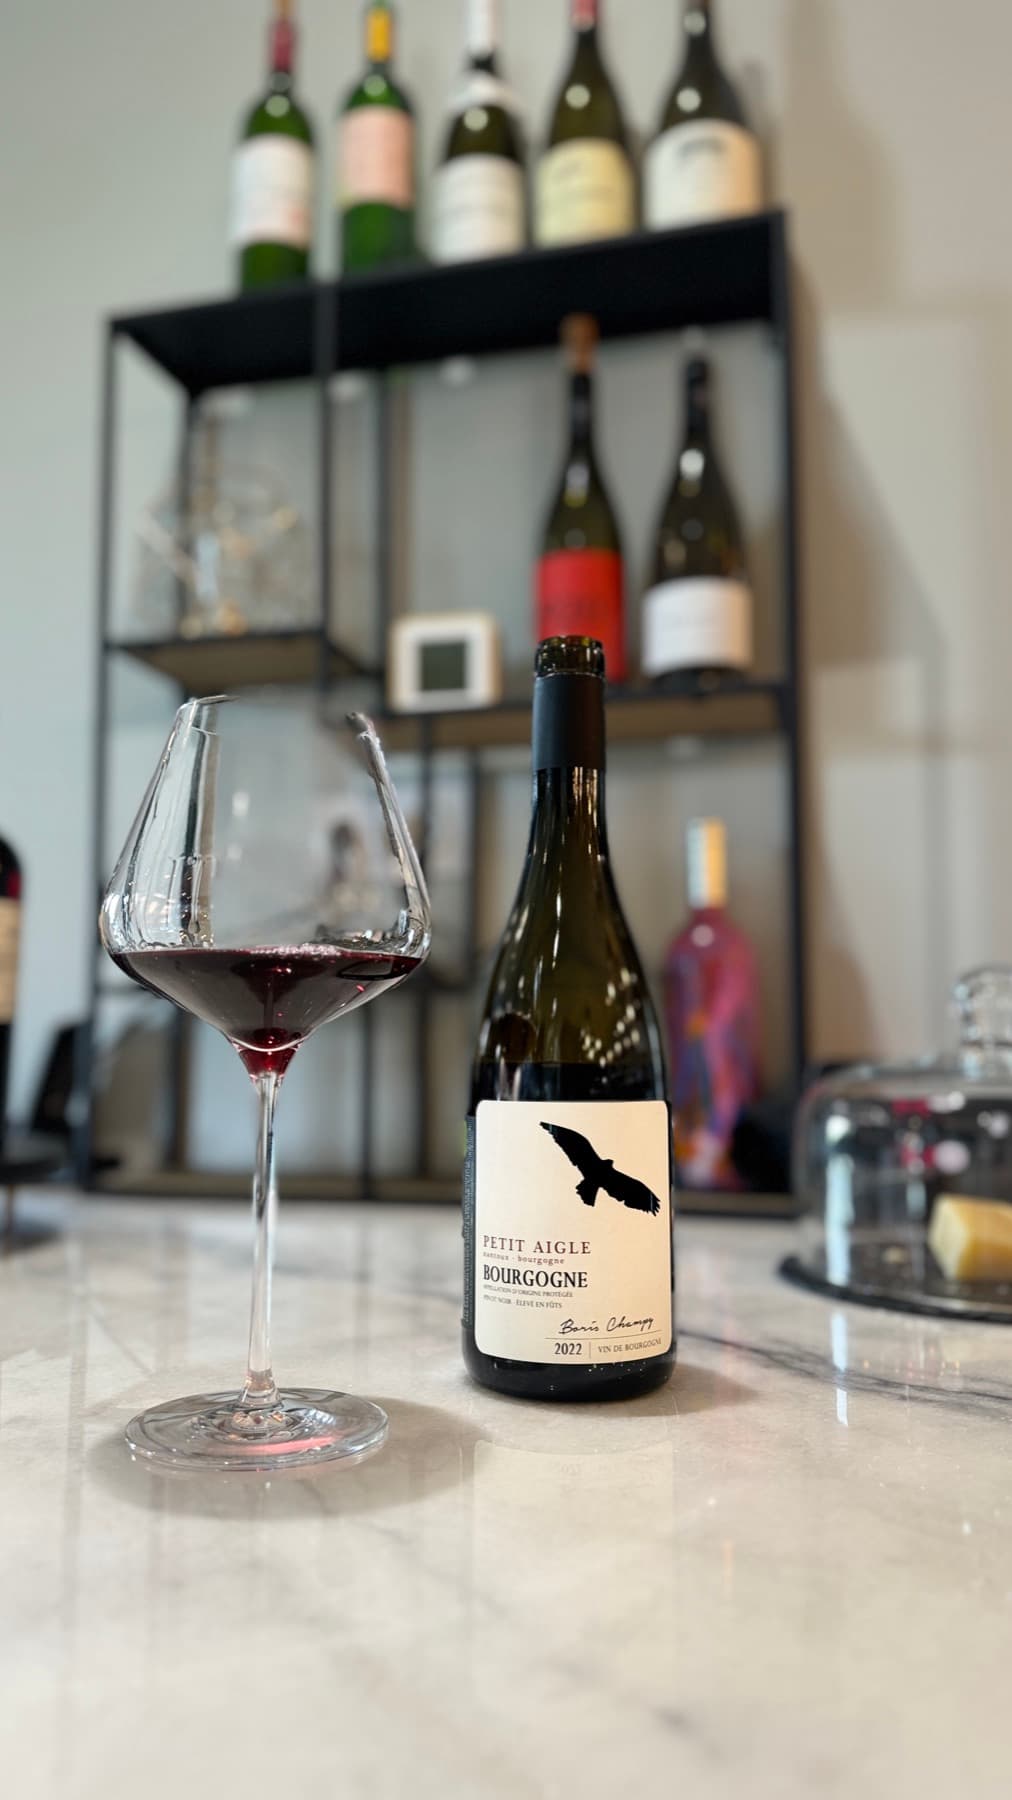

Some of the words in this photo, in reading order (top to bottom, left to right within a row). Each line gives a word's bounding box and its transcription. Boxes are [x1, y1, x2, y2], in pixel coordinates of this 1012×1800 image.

[483, 1235, 525, 1252] PETIT
[533, 1241, 592, 1254] AIGLE
[517, 1255, 565, 1266] bourgogne
[483, 1264, 588, 1288] BOURGOGNE
[558, 1318, 599, 1335] Boris
[554, 1342, 583, 1356] 2022
[598, 1345, 612, 1353] VIN
[613, 1344, 624, 1353] DE
